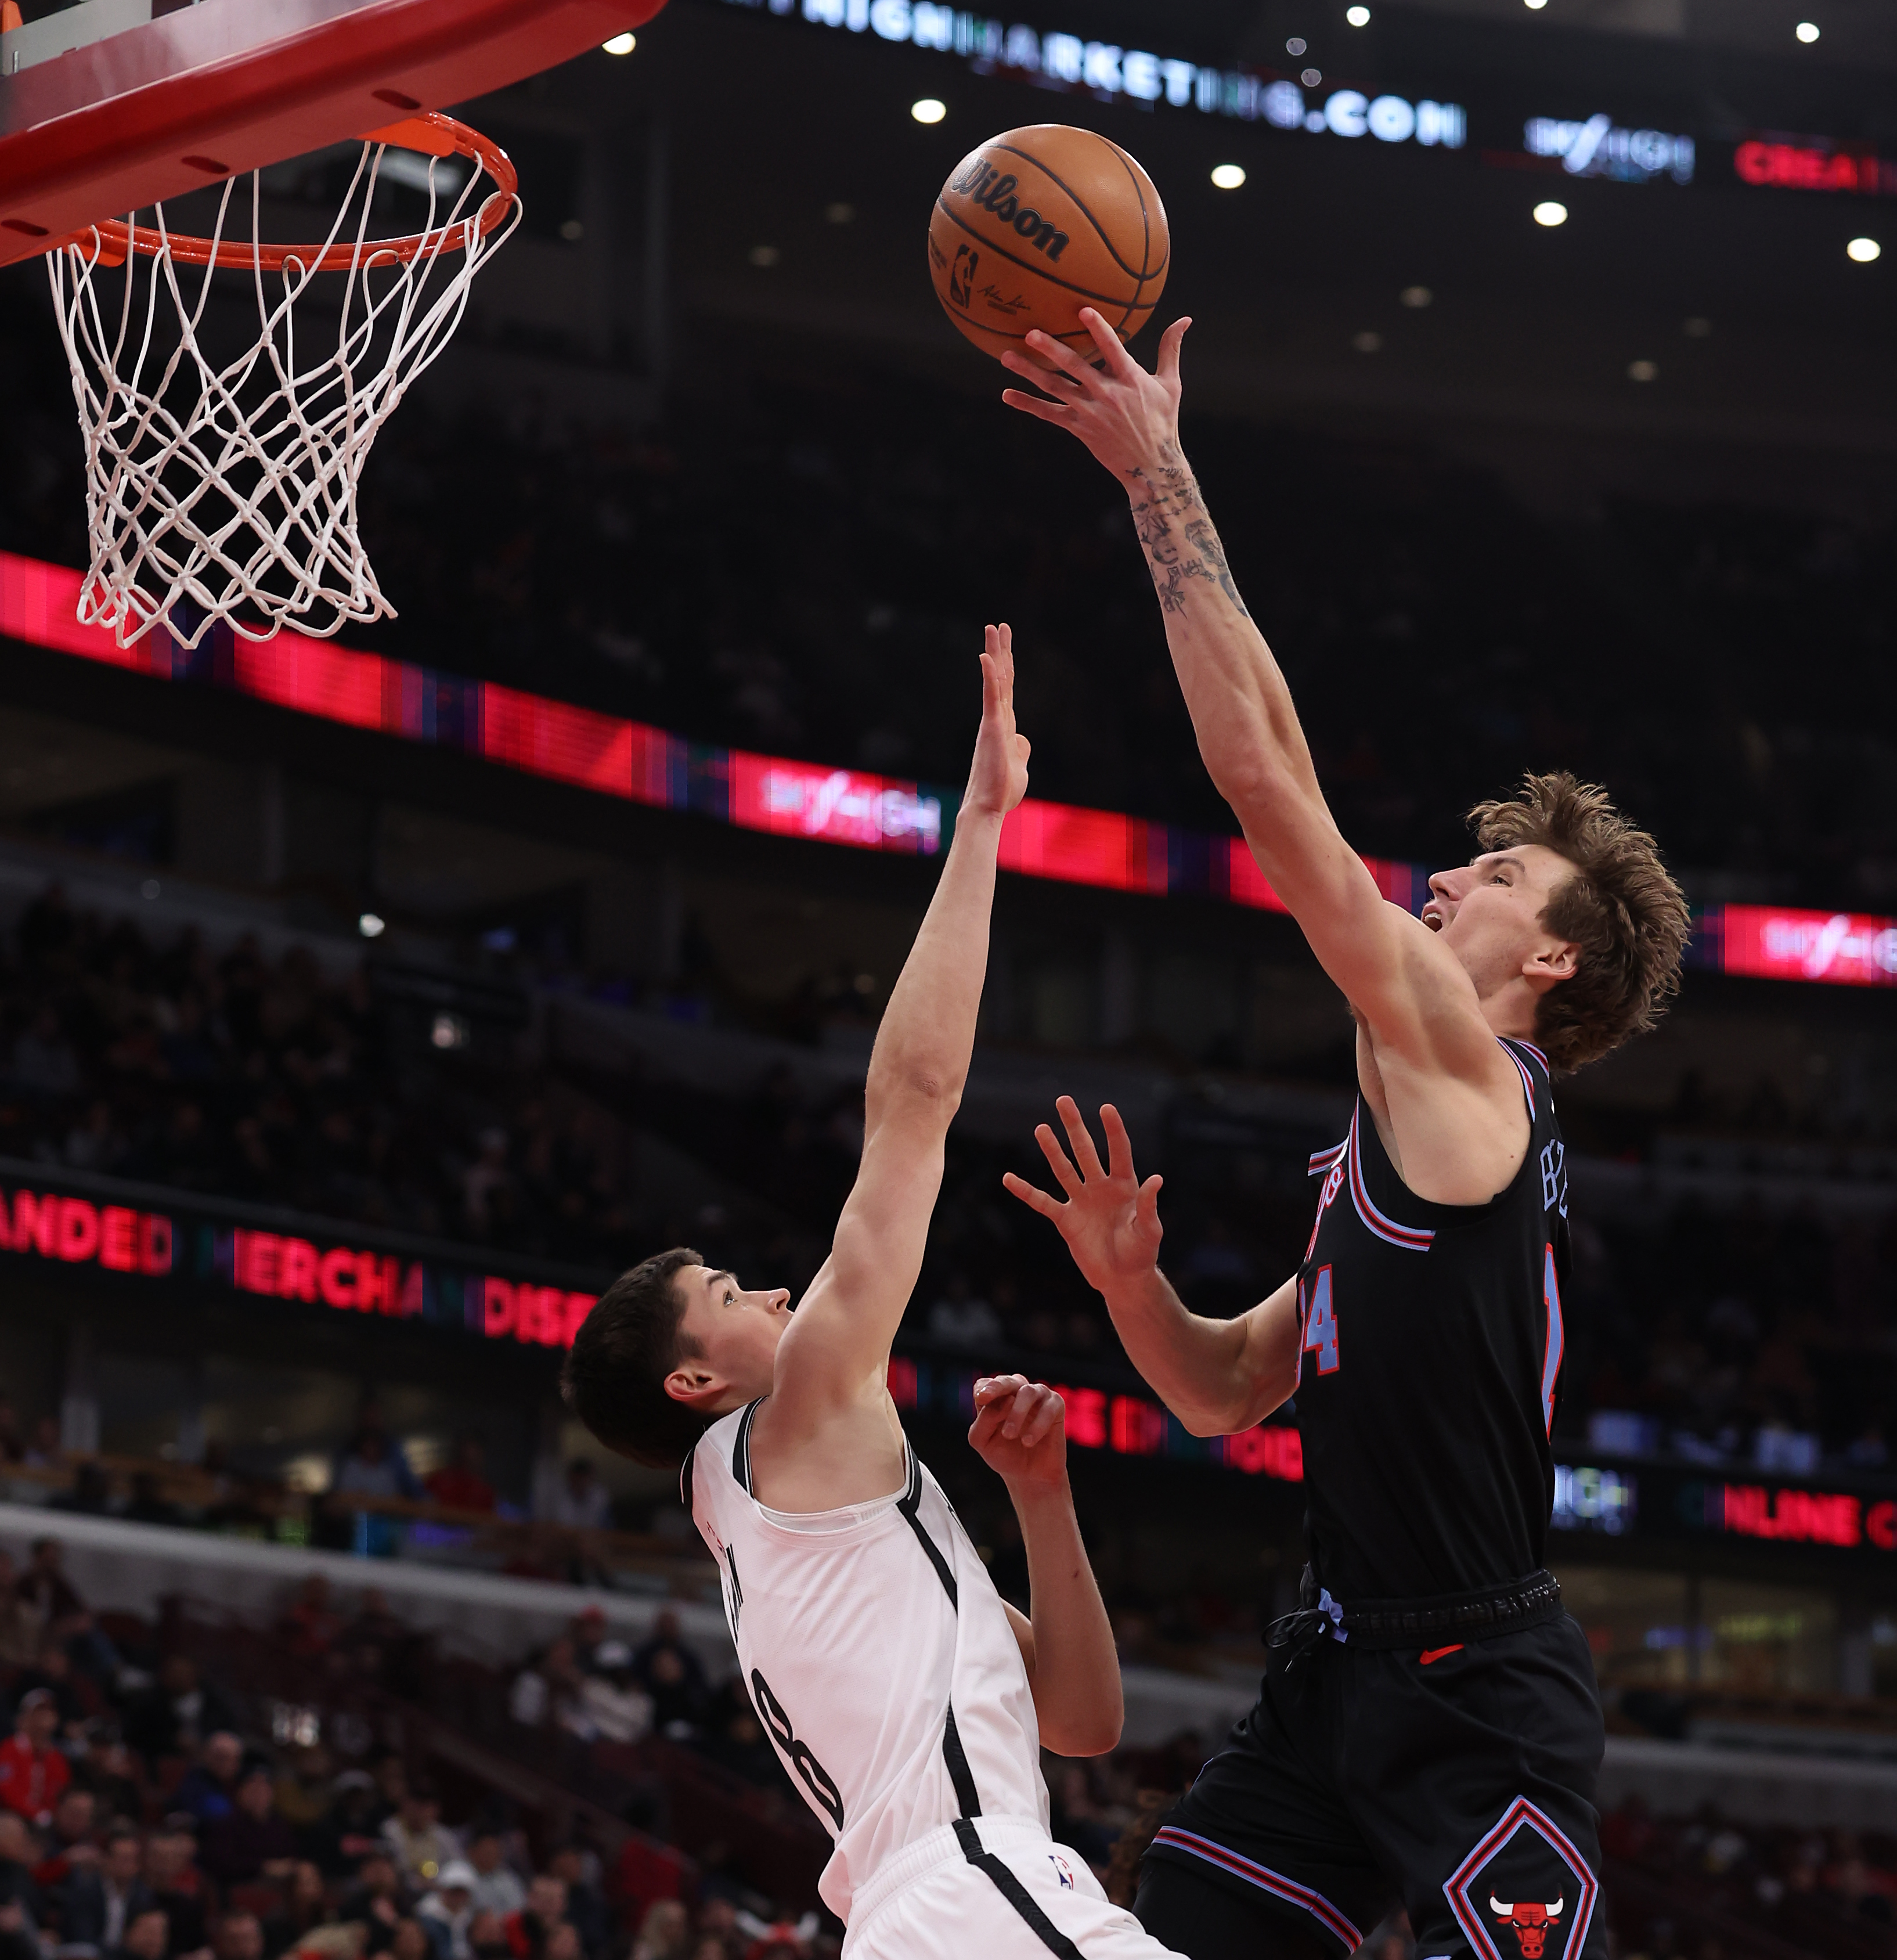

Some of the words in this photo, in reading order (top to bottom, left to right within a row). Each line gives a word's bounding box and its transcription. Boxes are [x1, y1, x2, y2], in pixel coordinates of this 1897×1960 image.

[952, 157, 1070, 264] Wilson
[1683, 1480, 1861, 1549] NLINE
[751, 1667, 845, 1832] 8
